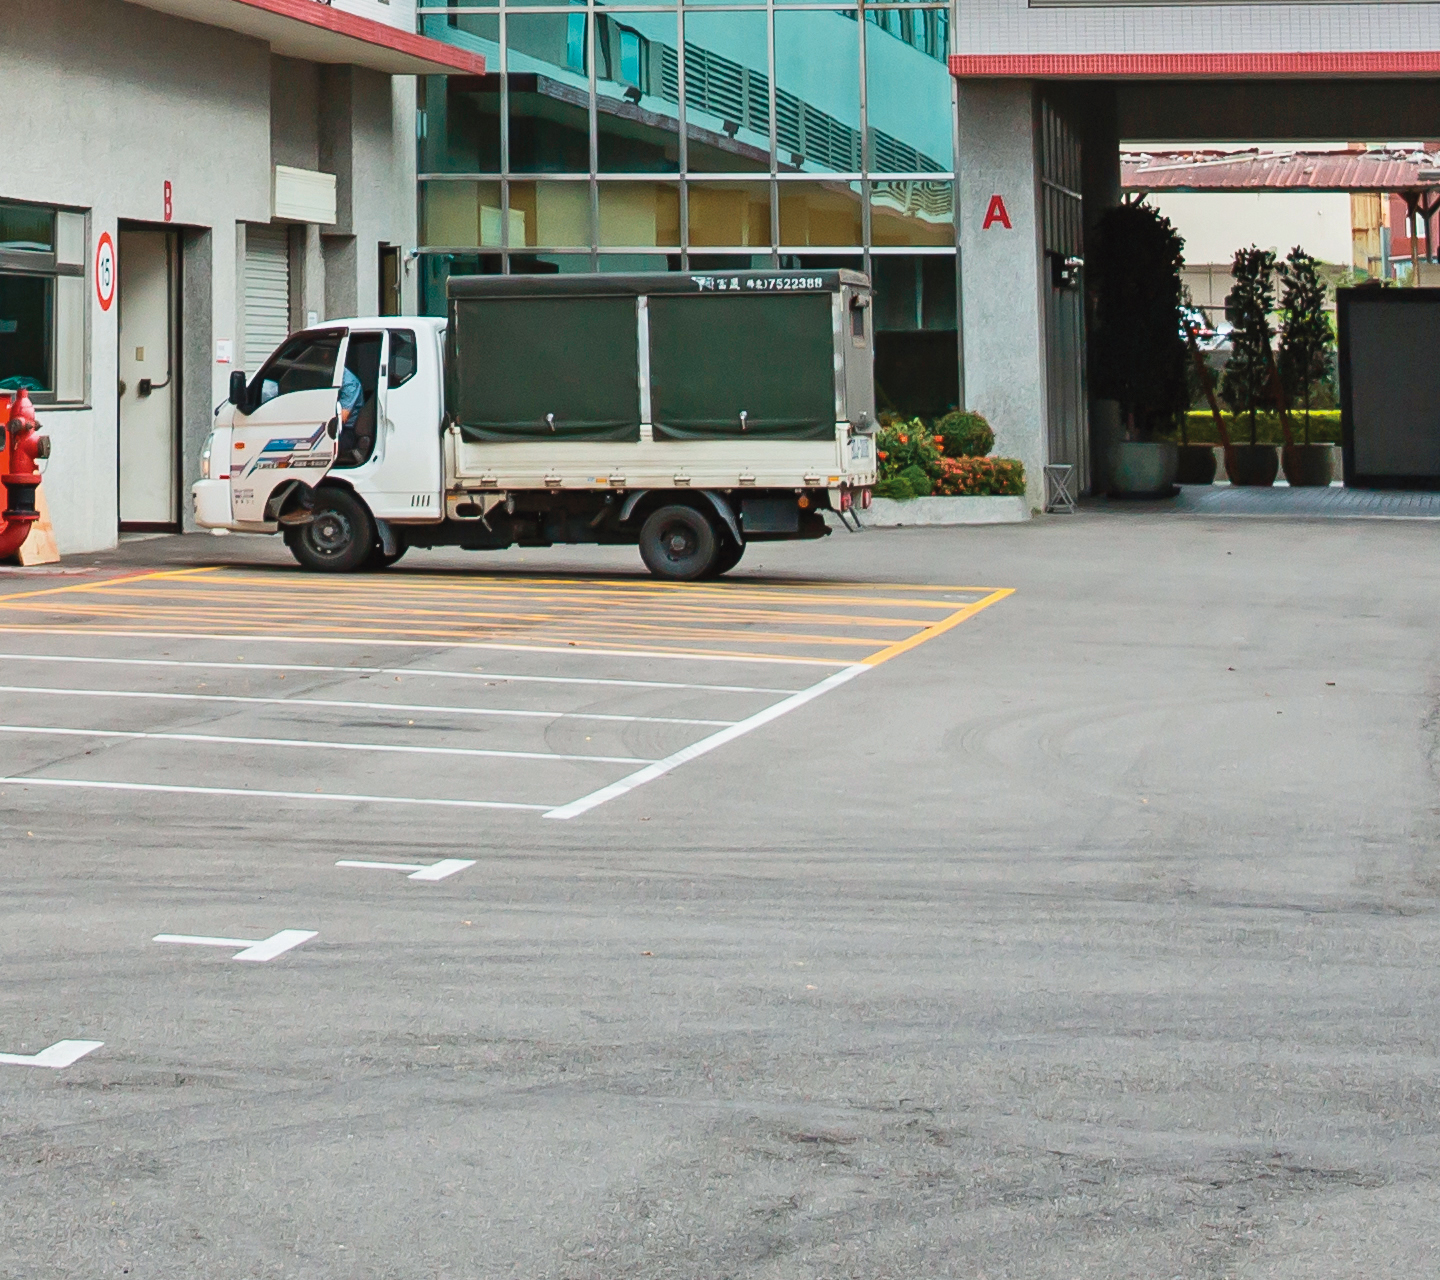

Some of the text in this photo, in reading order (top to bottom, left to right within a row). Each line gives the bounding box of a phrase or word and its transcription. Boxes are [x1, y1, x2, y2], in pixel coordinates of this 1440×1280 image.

[164, 180, 172, 222] B
[982, 194, 1012, 230] A
[100, 258, 111, 287] 15
